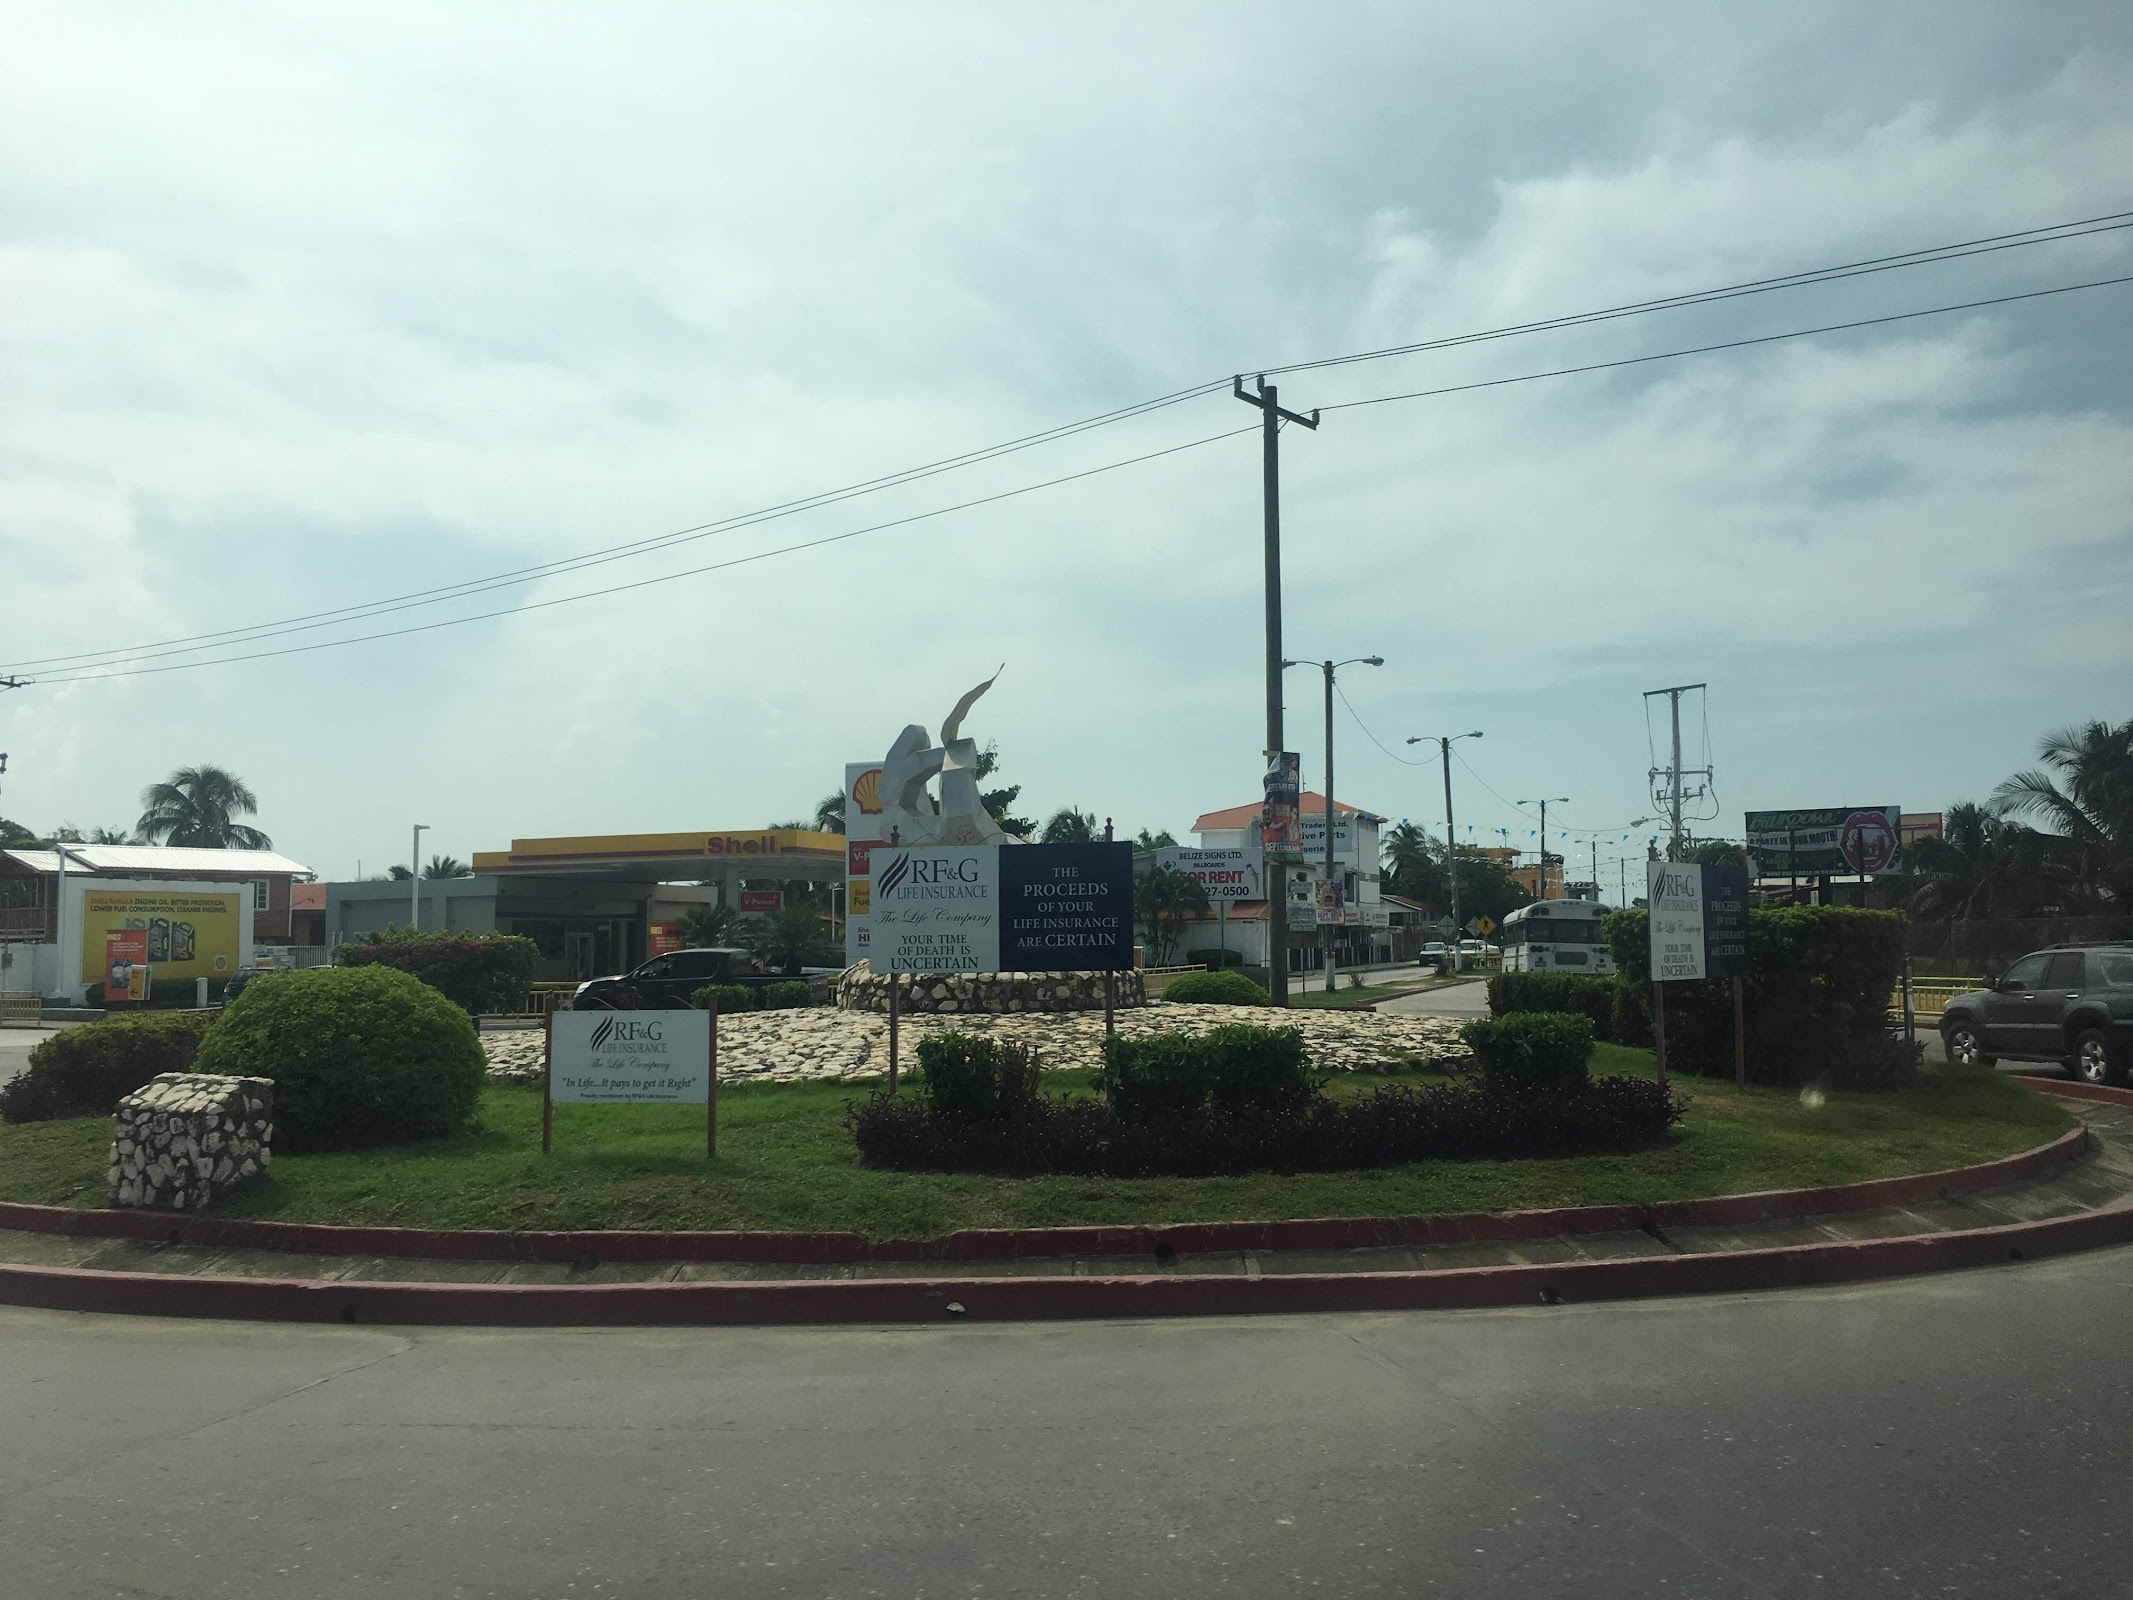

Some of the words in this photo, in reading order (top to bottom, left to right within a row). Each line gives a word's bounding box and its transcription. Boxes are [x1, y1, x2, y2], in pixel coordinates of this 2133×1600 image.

[1319, 831, 1346, 840] Prts
[707, 835, 776, 854] Shell
[1303, 844, 1325, 852] sorie
[1179, 852, 1204, 861] BELIZE
[1204, 851, 1227, 860] SIGNS
[1227, 851, 1244, 860] LTD.
[910, 858, 978, 884] RF&G
[1052, 867, 1079, 878] THE
[1208, 870, 1245, 884] RENT
[897, 886, 919, 900] LIFE
[920, 885, 988, 900] INSURANCE
[1023, 882, 1109, 897] PROCEEDS
[135, 898, 158, 906] ENGINE
[1037, 901, 1056, 912] OF
[1057, 901, 1094, 912] YOUR
[113, 905, 129, 913] FUEL
[177, 906, 201, 914] CLEANER
[875, 910, 899, 924] The
[900, 908, 928, 926] Life
[930, 907, 992, 927] Company
[1013, 918, 1041, 929] LIFE
[1043, 917, 1119, 929] INSURANCE
[902, 934, 933, 945] YOUR
[938, 934, 967, 944] TIME
[1017, 936, 1043, 947] ARE
[1045, 933, 1117, 947] CERTAIN
[897, 946, 915, 956] OF
[915, 945, 955, 956] DEATH
[961, 945, 971, 955] IS
[891, 956, 979, 970] UNCERTAIN
[1661, 964, 1698, 977] UNCERTAIN
[613, 1021, 663, 1041] RF&G
[602, 1042, 618, 1054] LIFE
[618, 1042, 668, 1054] INSURANCE
[628, 1056, 671, 1072] Company
[610, 1079, 630, 1090] pays
[632, 1078, 641, 1087] to
[642, 1079, 657, 1090] get
[658, 1077, 665, 1087] it
